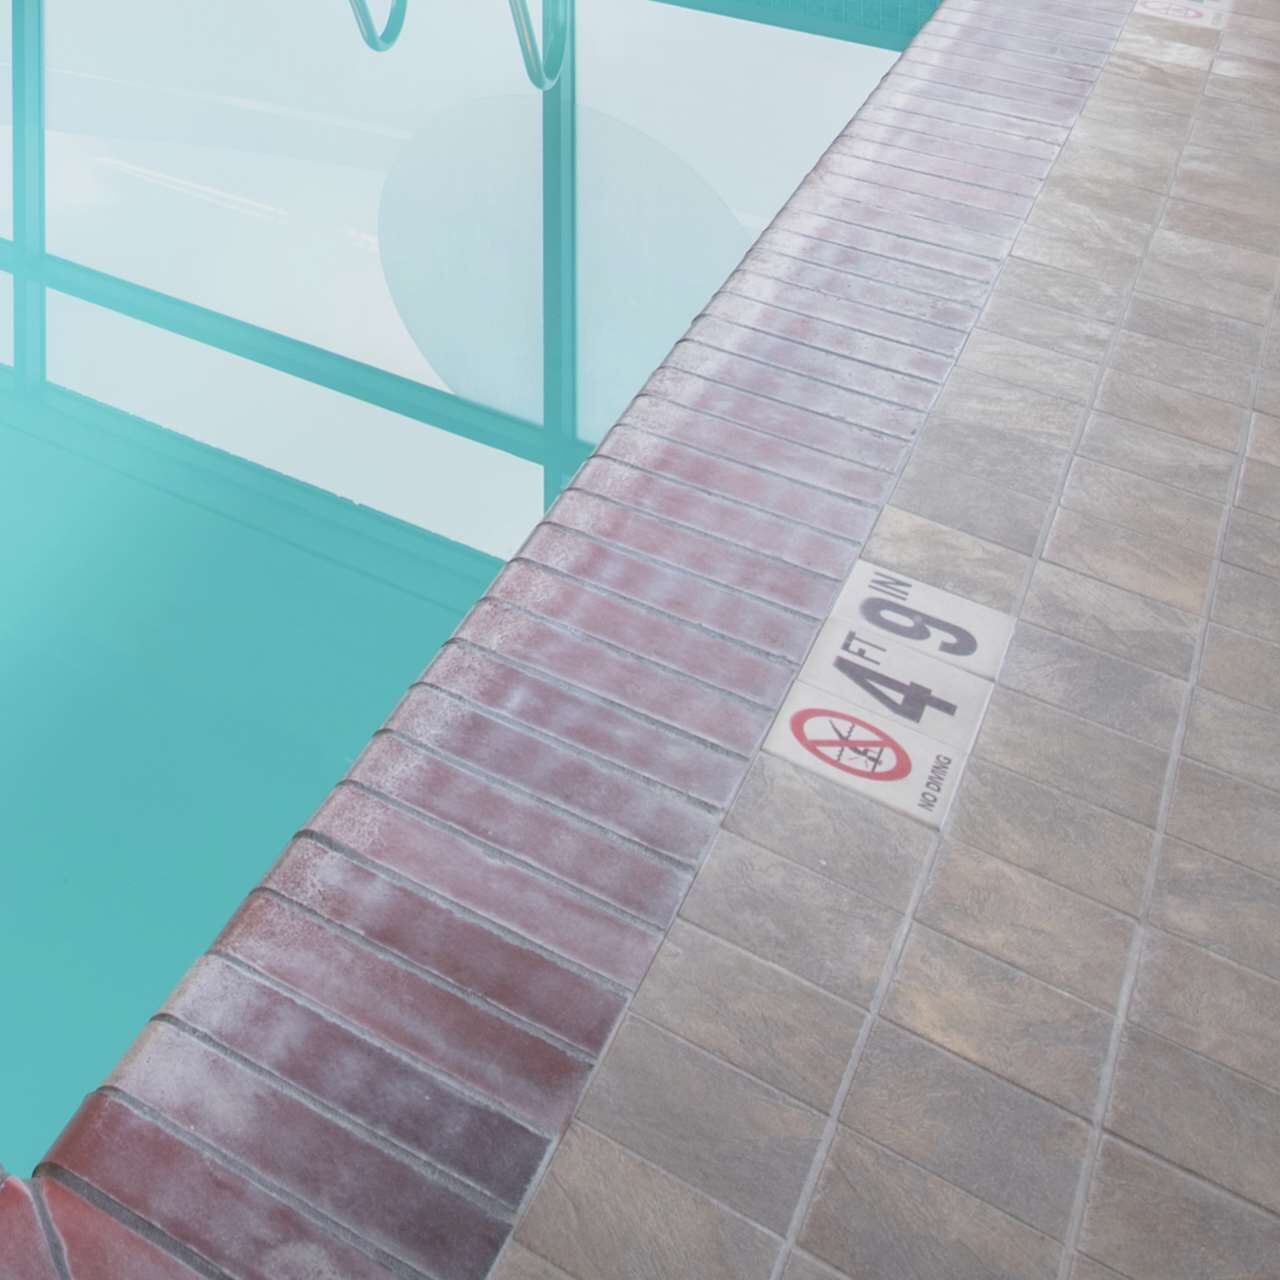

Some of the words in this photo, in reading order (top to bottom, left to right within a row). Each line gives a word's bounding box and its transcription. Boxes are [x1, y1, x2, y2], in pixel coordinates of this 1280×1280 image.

[868, 571, 913, 601] IN
[859, 596, 978, 657] 9
[841, 630, 887, 666] FT
[833, 655, 958, 723] 4
[925, 754, 952, 793] DIVING
[917, 791, 937, 812] NO
